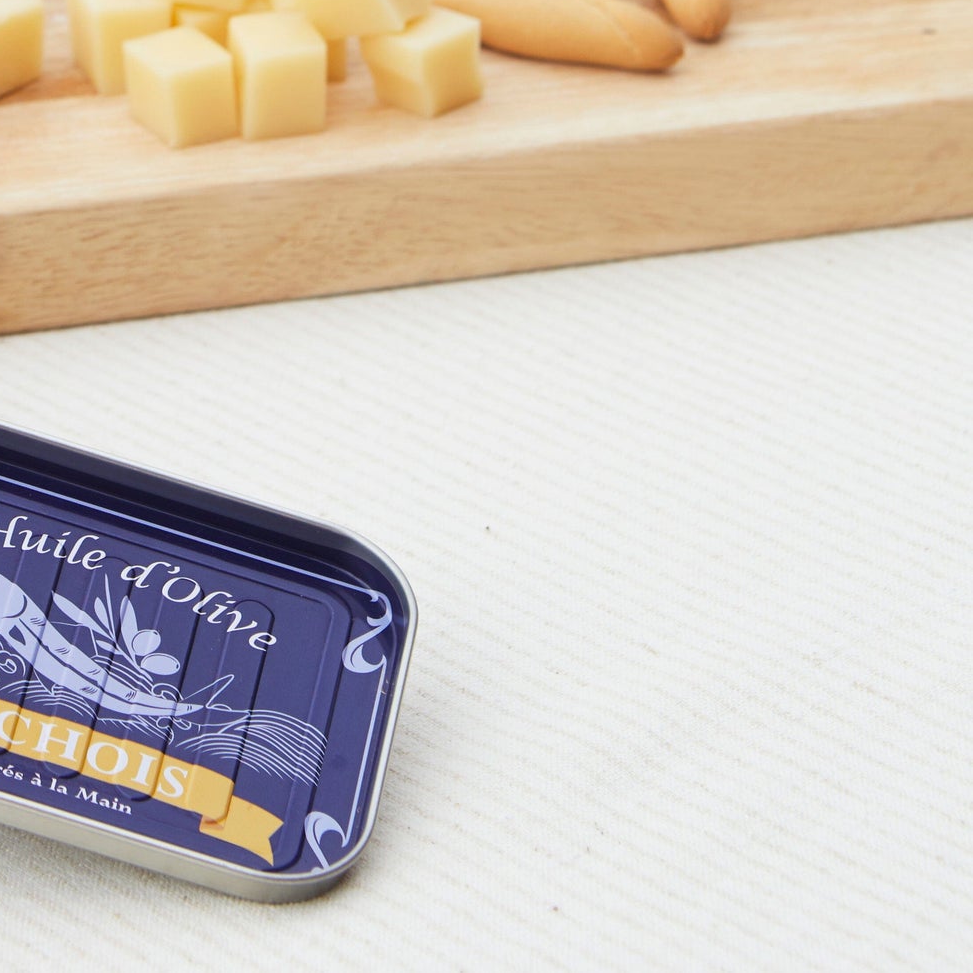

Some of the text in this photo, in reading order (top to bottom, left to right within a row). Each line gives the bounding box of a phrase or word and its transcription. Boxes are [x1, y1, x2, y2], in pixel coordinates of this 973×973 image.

[120, 561, 277, 652] d'Olive
[30, 772, 43, 787] à
[49, 777, 68, 795] la
[74, 786, 132, 815] Main
